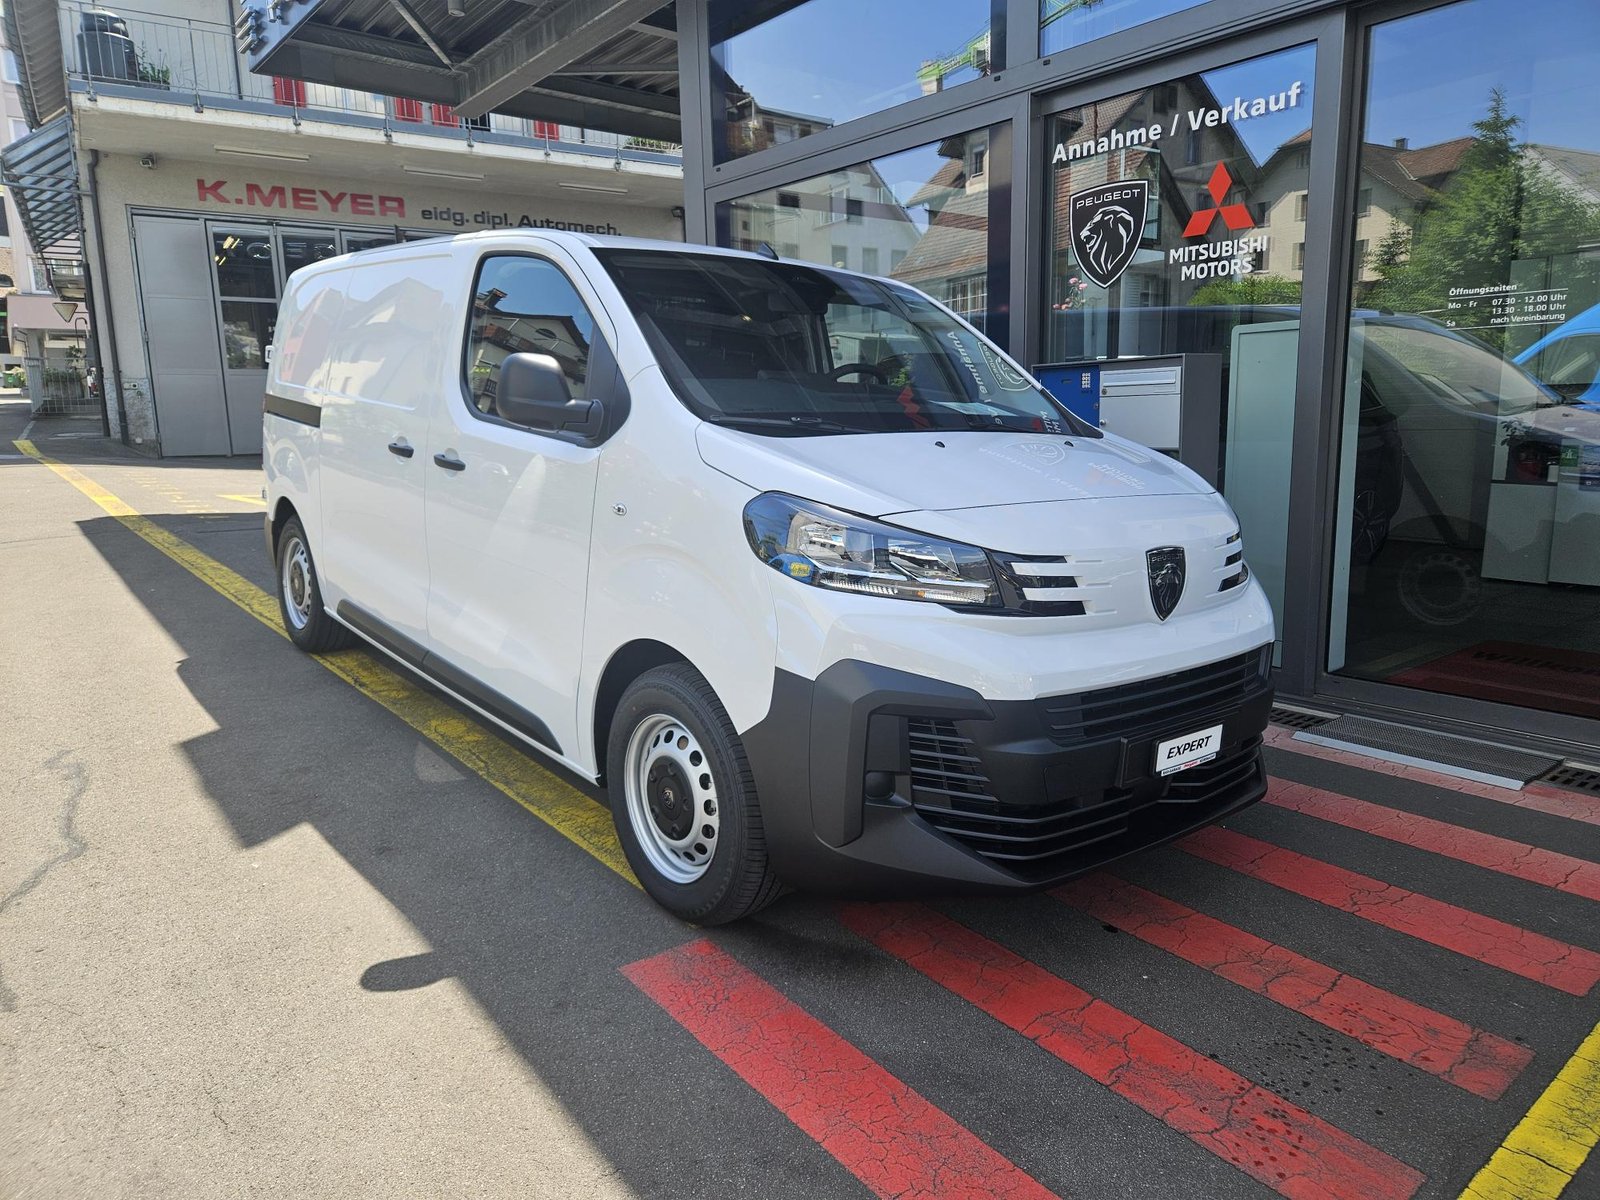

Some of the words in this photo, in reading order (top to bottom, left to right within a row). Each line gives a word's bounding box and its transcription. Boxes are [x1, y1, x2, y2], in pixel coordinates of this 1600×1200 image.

[1051, 123, 1162, 164] Annahme
[1169, 113, 1180, 137] /
[1188, 81, 1302, 131] Verkauf
[196, 178, 406, 218] K.MEYER
[1076, 188, 1141, 210] PEUGEOT
[421, 207, 470, 227] eidg.
[473, 210, 514, 229] dipl.
[517, 214, 622, 236] Automech.
[1169, 235, 1268, 265] MITSUBISHI
[1180, 257, 1255, 282] MOTORS
[1447, 302, 1461, 310] Mo
[1469, 300, 1478, 308] Fr
[1492, 297, 1516, 306] 07.30
[1524, 295, 1548, 303] 12.00
[1550, 293, 1567, 301] Uhr
[1449, 284, 1517, 296] Öffnungszeiten
[1490, 315, 1509, 324] nach
[1511, 313, 1566, 323] Vereinbarung
[1492, 306, 1515, 315] 13.30
[1524, 304, 1547, 312] 18.00
[1549, 303, 1566, 311] Uhr
[1166, 735, 1213, 760] EXPERT
